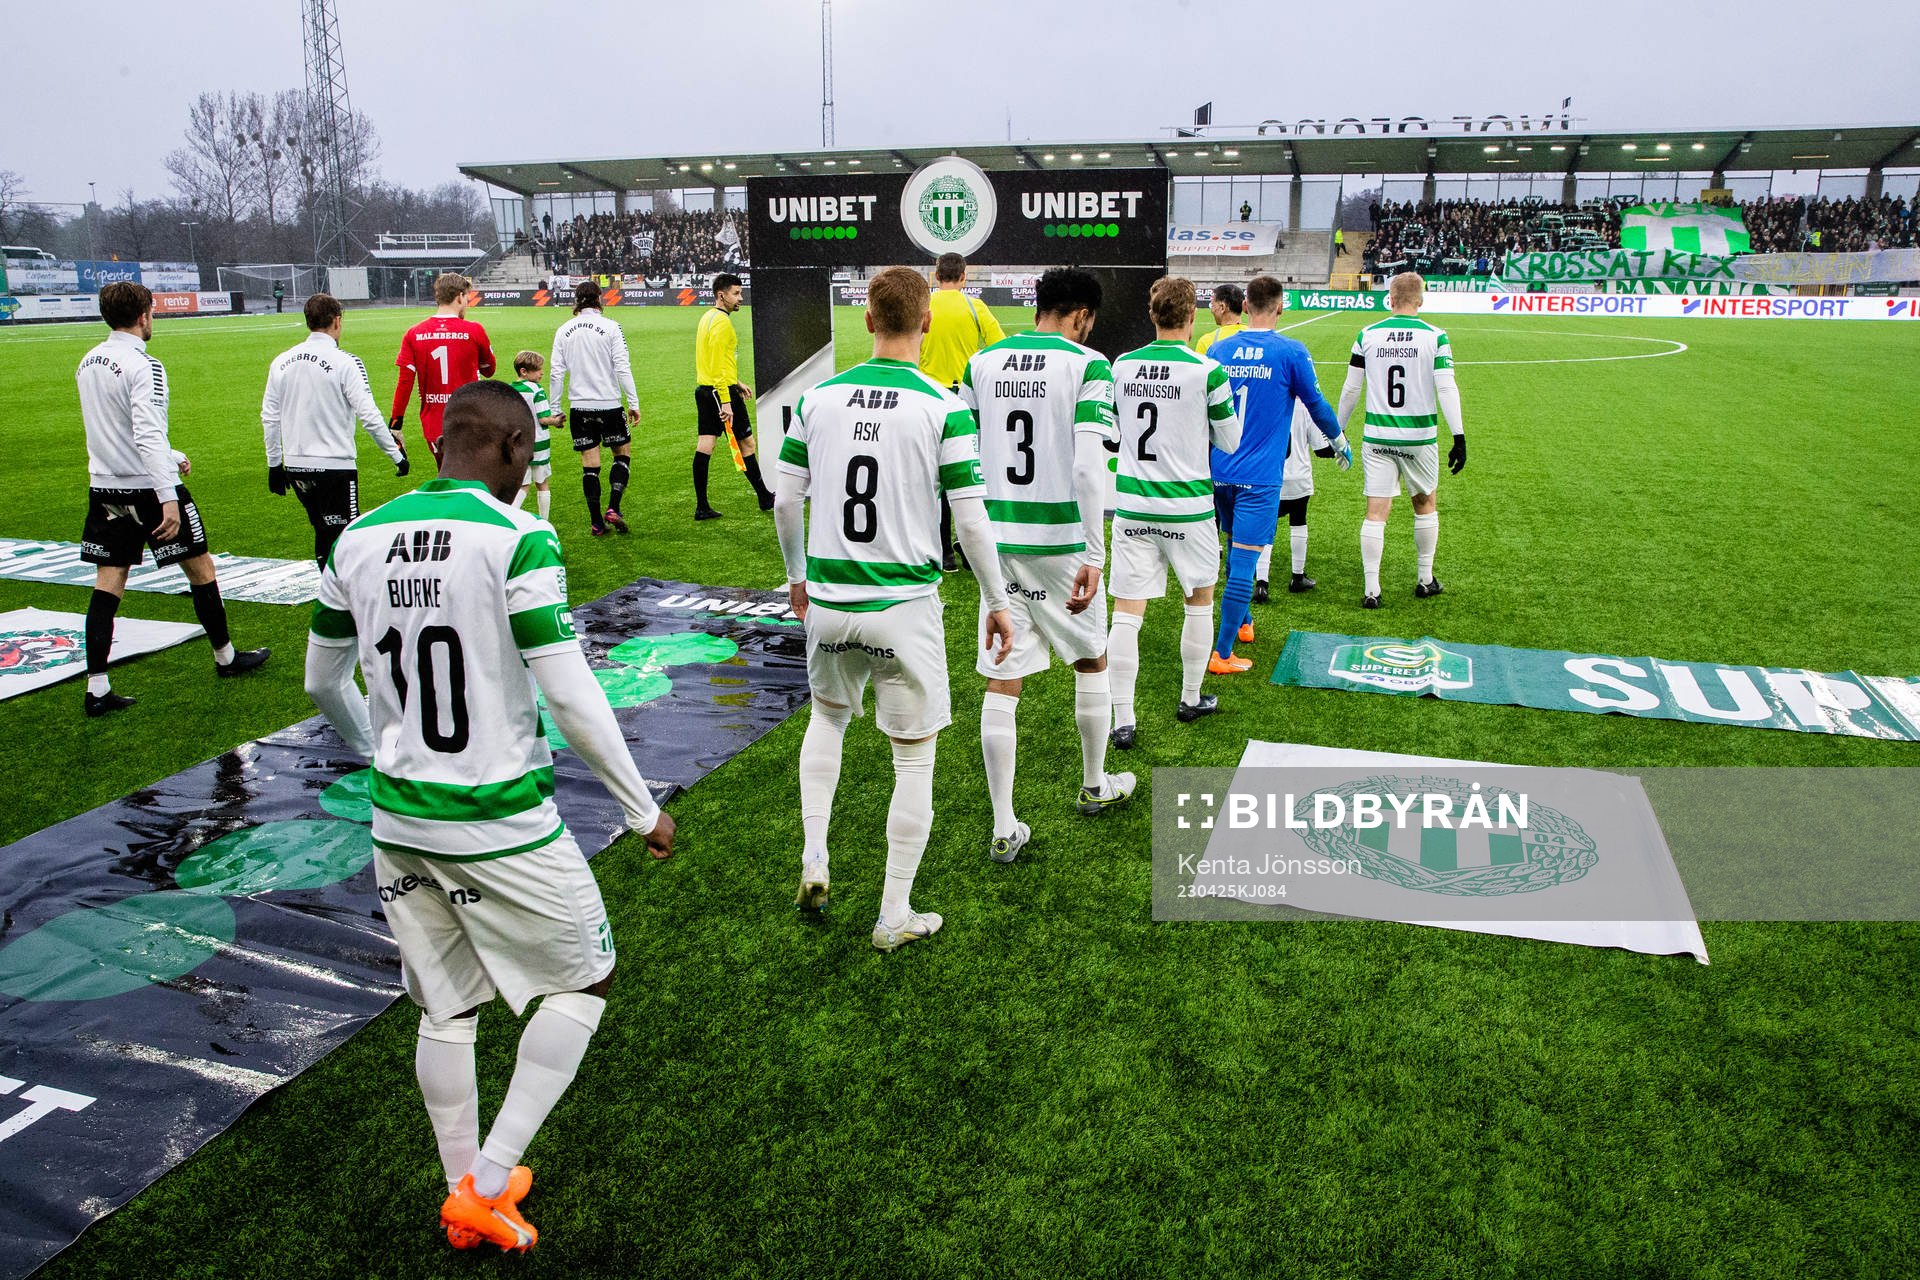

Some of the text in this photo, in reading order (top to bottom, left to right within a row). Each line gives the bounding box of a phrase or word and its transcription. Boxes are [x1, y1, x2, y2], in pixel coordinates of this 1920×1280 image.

[769, 195, 877, 222] UNIBET
[1021, 191, 1143, 219] UNIBET
[1168, 227, 1256, 241] las.se
[1168, 244, 1227, 252] RUPPEN
[1505, 248, 1655, 281] KROSSAT
[1662, 249, 1738, 280] KEX
[164, 296, 190, 306] renta
[1300, 292, 1375, 309] VÄSTERÅS
[1512, 296, 1647, 314] INTERSPORT
[1703, 298, 1849, 317] INTERSPORT
[415, 332, 470, 341] MALMBERGS
[1387, 331, 1414, 342] ABB
[1232, 346, 1265, 361] ABB
[1375, 347, 1419, 359] JOHANSSON
[319, 360, 333, 373] SK
[431, 345, 449, 385] 1
[1002, 354, 1047, 372] ABB
[1135, 364, 1171, 381] ABB
[995, 381, 1047, 399] DOUGLAS
[1123, 383, 1181, 400] MAGNUSSON
[1387, 364, 1406, 409] 6
[846, 389, 899, 410] ABB
[853, 421, 880, 442] ASK
[1136, 401, 1159, 462] 2
[1006, 409, 1035, 486] 3
[843, 454, 879, 543] 8
[1124, 526, 1186, 541] axelssons
[386, 530, 452, 564] ABB
[388, 577, 441, 609] BURKE
[658, 594, 796, 618] UNIB
[1350, 663, 1452, 680] SUPERETTAN
[375, 625, 470, 754] 10
[1534, 832, 1568, 846] 04
